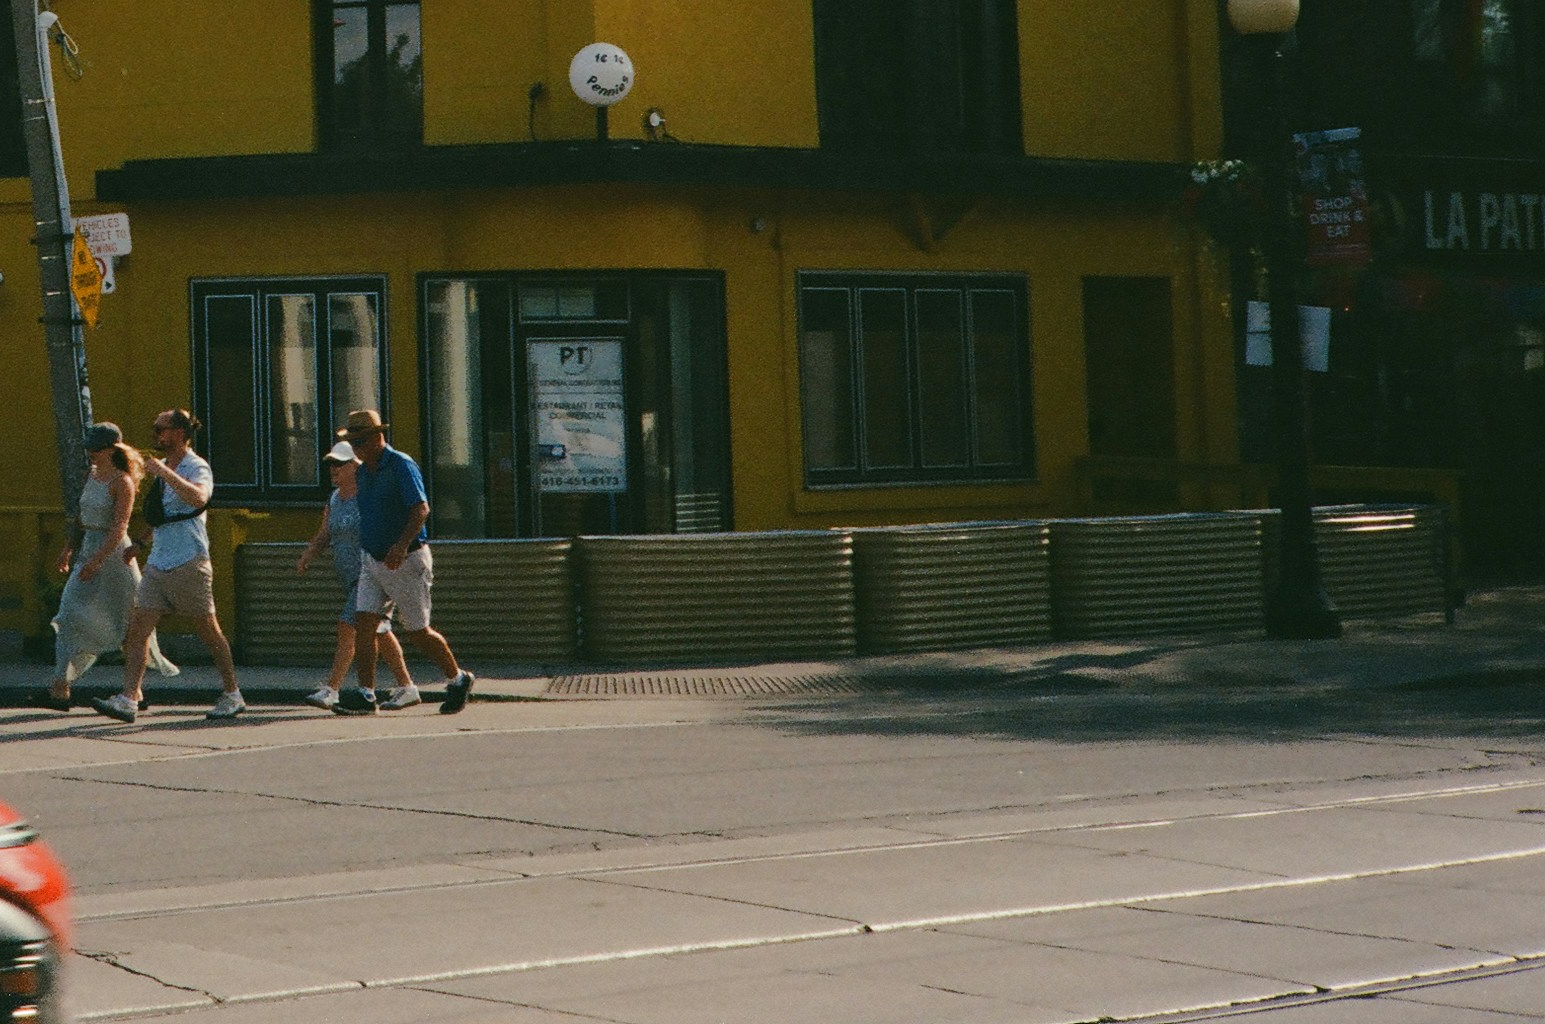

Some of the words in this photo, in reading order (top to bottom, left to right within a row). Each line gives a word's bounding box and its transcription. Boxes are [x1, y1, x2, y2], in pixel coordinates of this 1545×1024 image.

[586, 75, 629, 96] Pennies
[1314, 196, 1353, 211] SHOP
[1309, 211, 1351, 225] DRINK
[1353, 209, 1363, 222] &
[1424, 189, 1469, 250] LA
[115, 229, 127, 239] TO
[1326, 224, 1351, 238] EAT
[560, 346, 589, 366] PT
